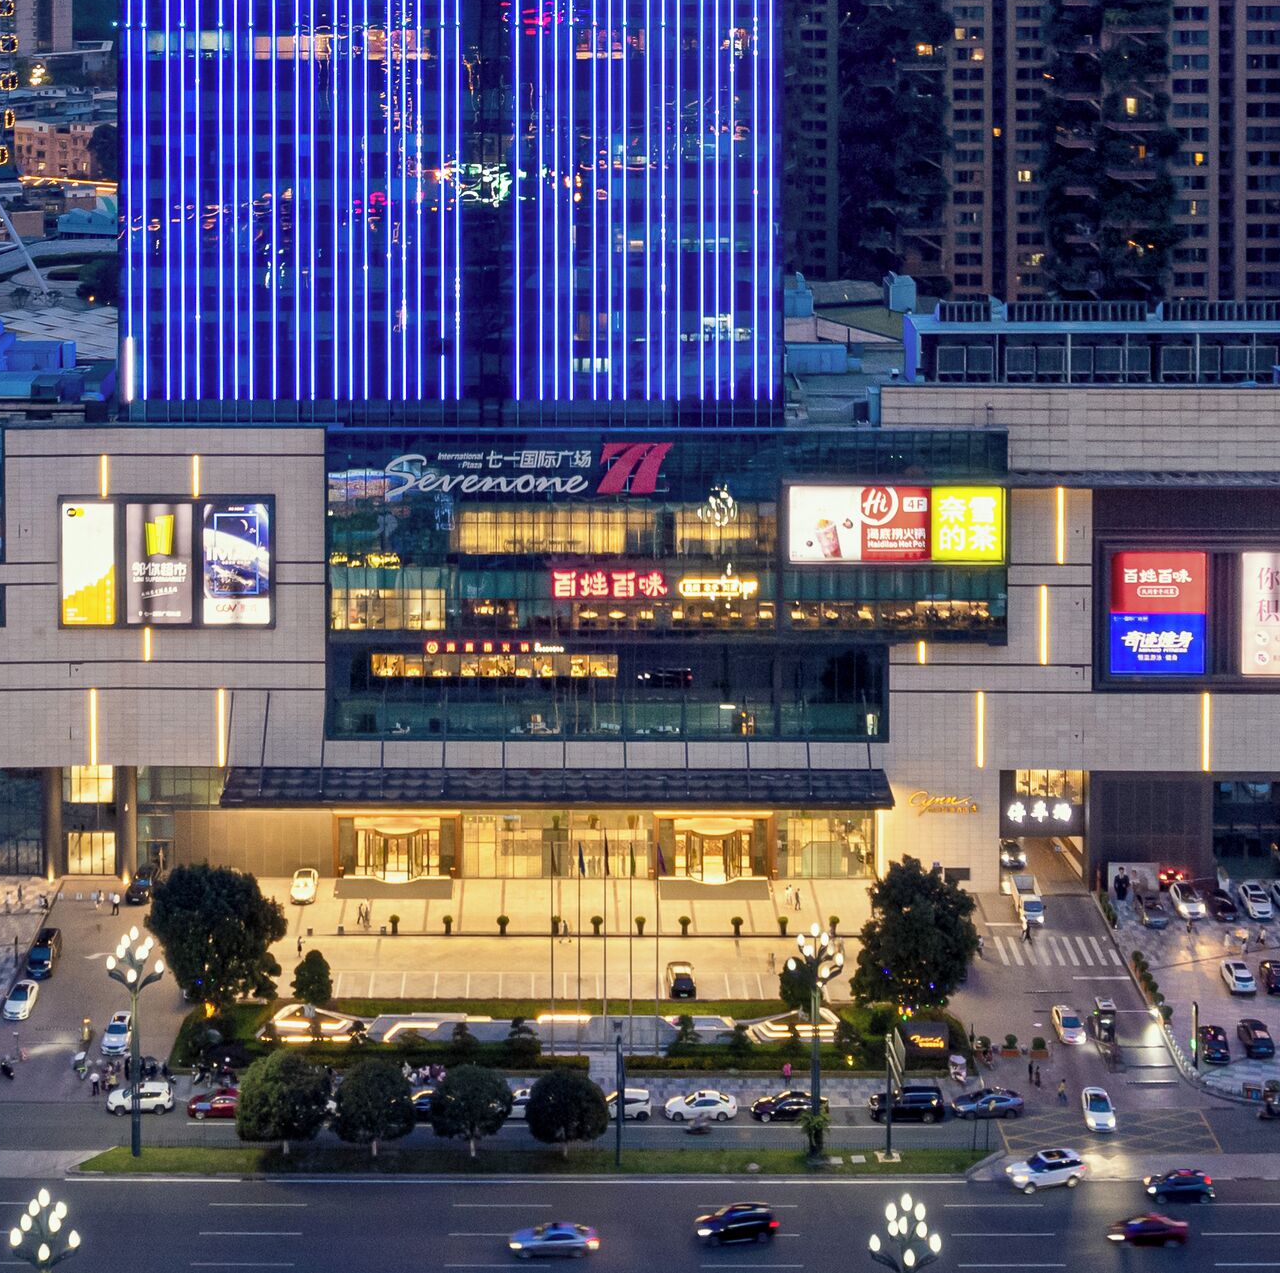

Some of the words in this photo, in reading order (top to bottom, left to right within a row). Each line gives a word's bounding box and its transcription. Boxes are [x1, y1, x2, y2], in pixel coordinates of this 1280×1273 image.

[437, 451, 484, 461] International
[461, 460, 483, 469] Plaza
[486, 450, 592, 469] 七一国际广场
[384, 453, 589, 497] Sevenone
[907, 499, 924, 510] 4F
[939, 495, 997, 524] 奈雪
[867, 527, 926, 540] 海底捞火锅
[939, 523, 997, 552] 的茶
[553, 570, 668, 597] 百姓百味
[1123, 568, 1192, 583] 百姓百味
